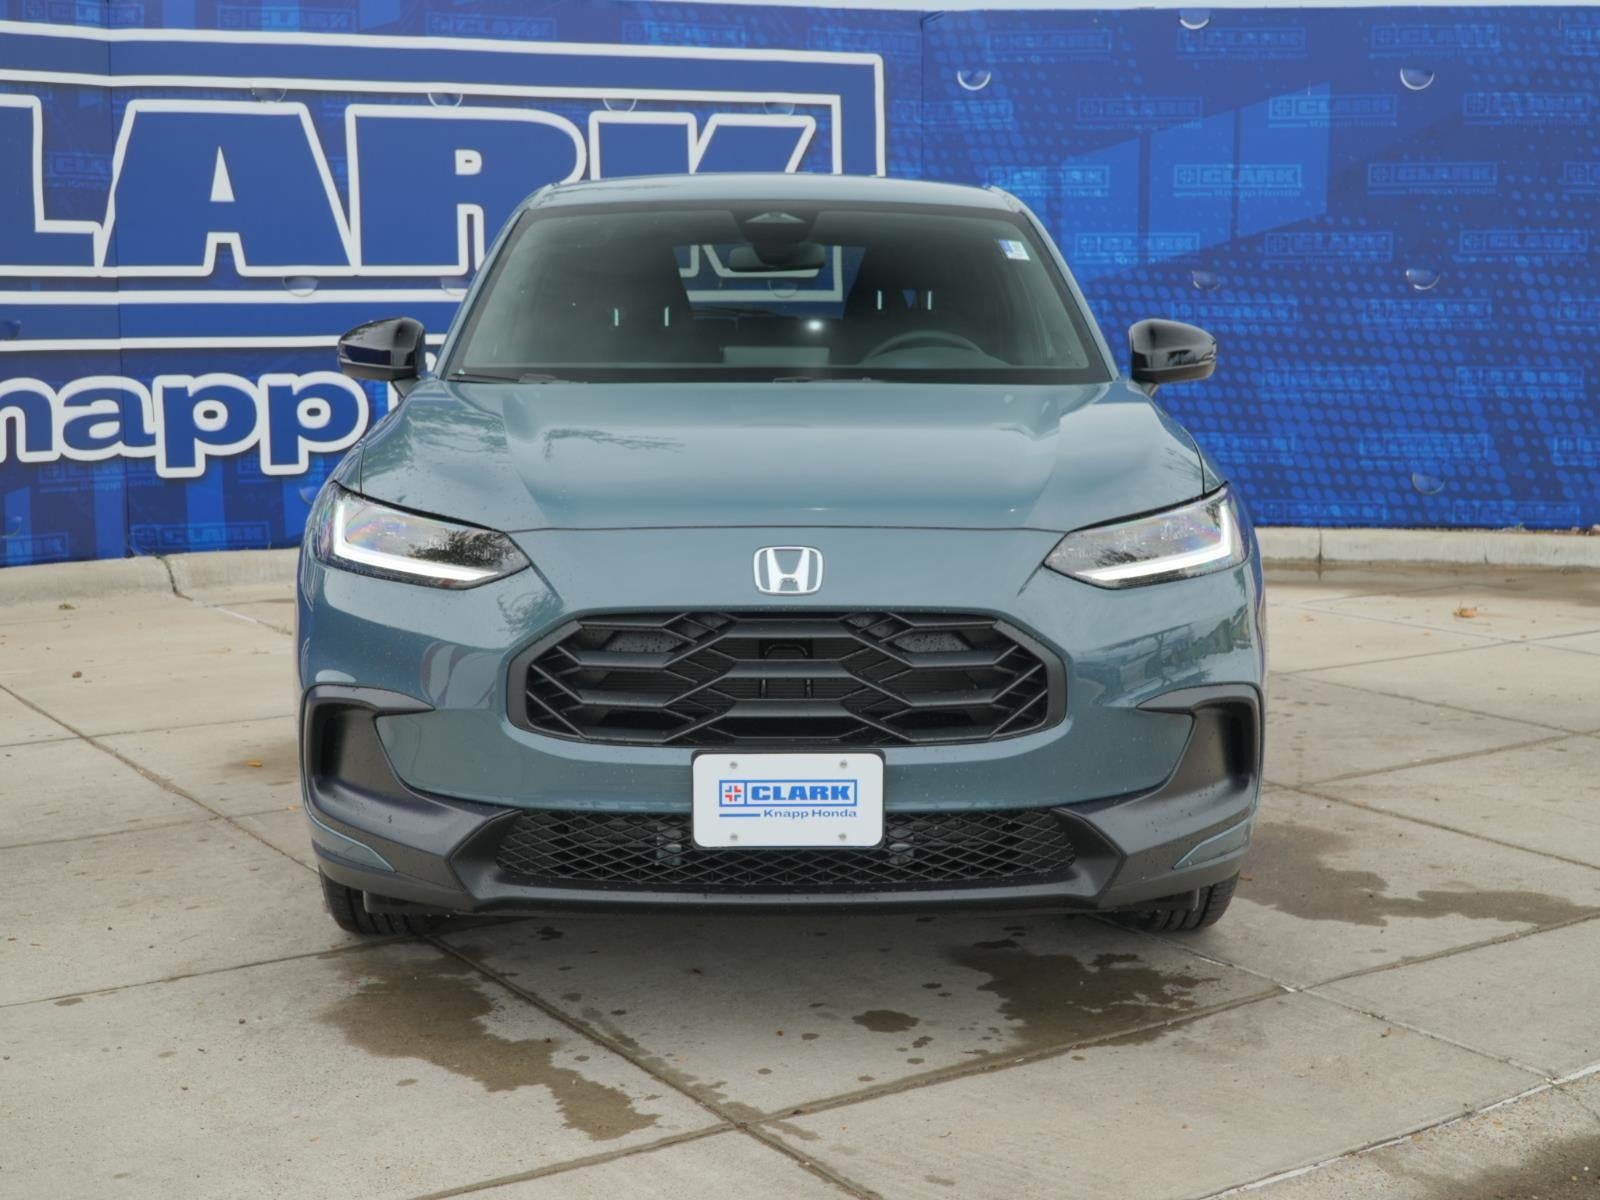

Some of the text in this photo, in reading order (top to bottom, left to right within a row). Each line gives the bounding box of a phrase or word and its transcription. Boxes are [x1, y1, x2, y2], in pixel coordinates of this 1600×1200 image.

[751, 785, 851, 801] CLARK
[763, 808, 857, 819] Knapp Honda
